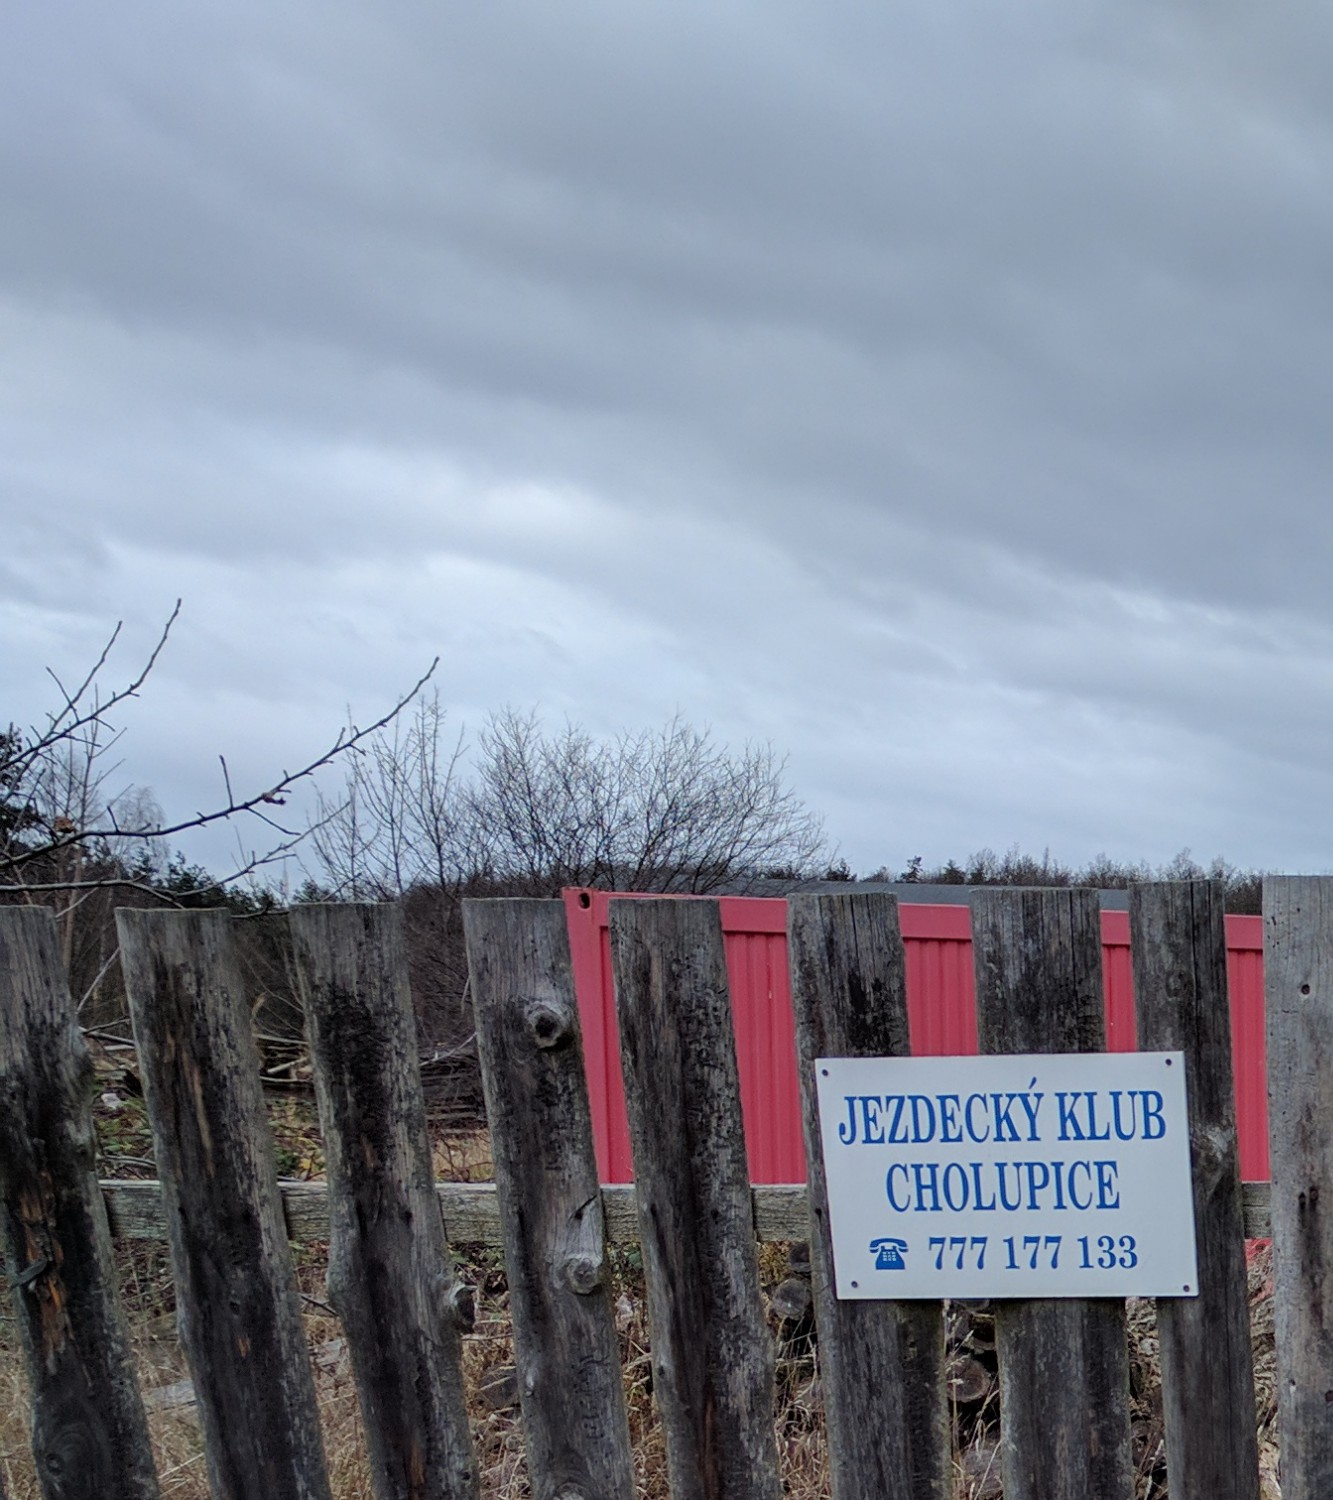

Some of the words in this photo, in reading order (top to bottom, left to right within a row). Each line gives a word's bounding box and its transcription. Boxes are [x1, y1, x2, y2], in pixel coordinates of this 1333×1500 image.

[838, 1075, 1045, 1147] JEZDECKÝ
[1053, 1089, 1168, 1143] KLUB
[884, 1159, 1121, 1214] CHOLUPICE
[927, 1235, 989, 1271] 777
[1002, 1234, 1063, 1271] 177
[1076, 1233, 1139, 1270] 133
